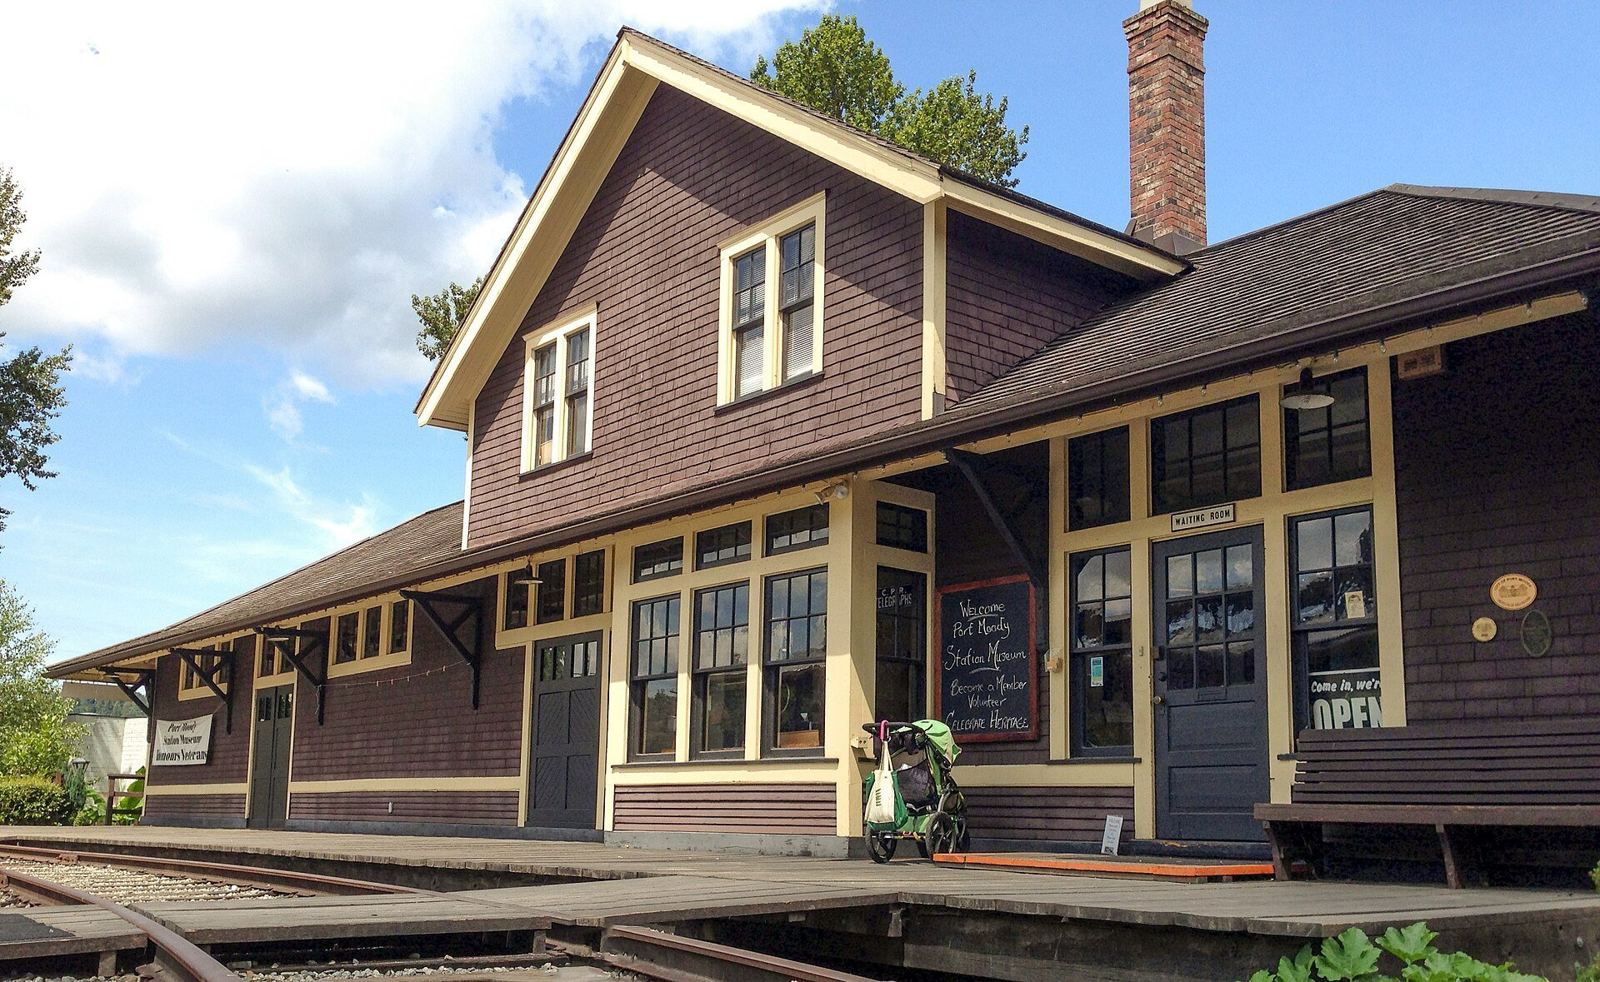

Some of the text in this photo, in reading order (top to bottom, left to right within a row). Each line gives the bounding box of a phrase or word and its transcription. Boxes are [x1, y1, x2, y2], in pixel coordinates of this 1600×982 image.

[1175, 509, 1231, 526] WAITING ROOM
[953, 617, 1011, 640] Port Moody
[944, 640, 1027, 671] Station Museum
[950, 674, 1028, 697] Become a Member
[1310, 677, 1382, 693] Come in, we'r
[967, 693, 1007, 709] Volunteer
